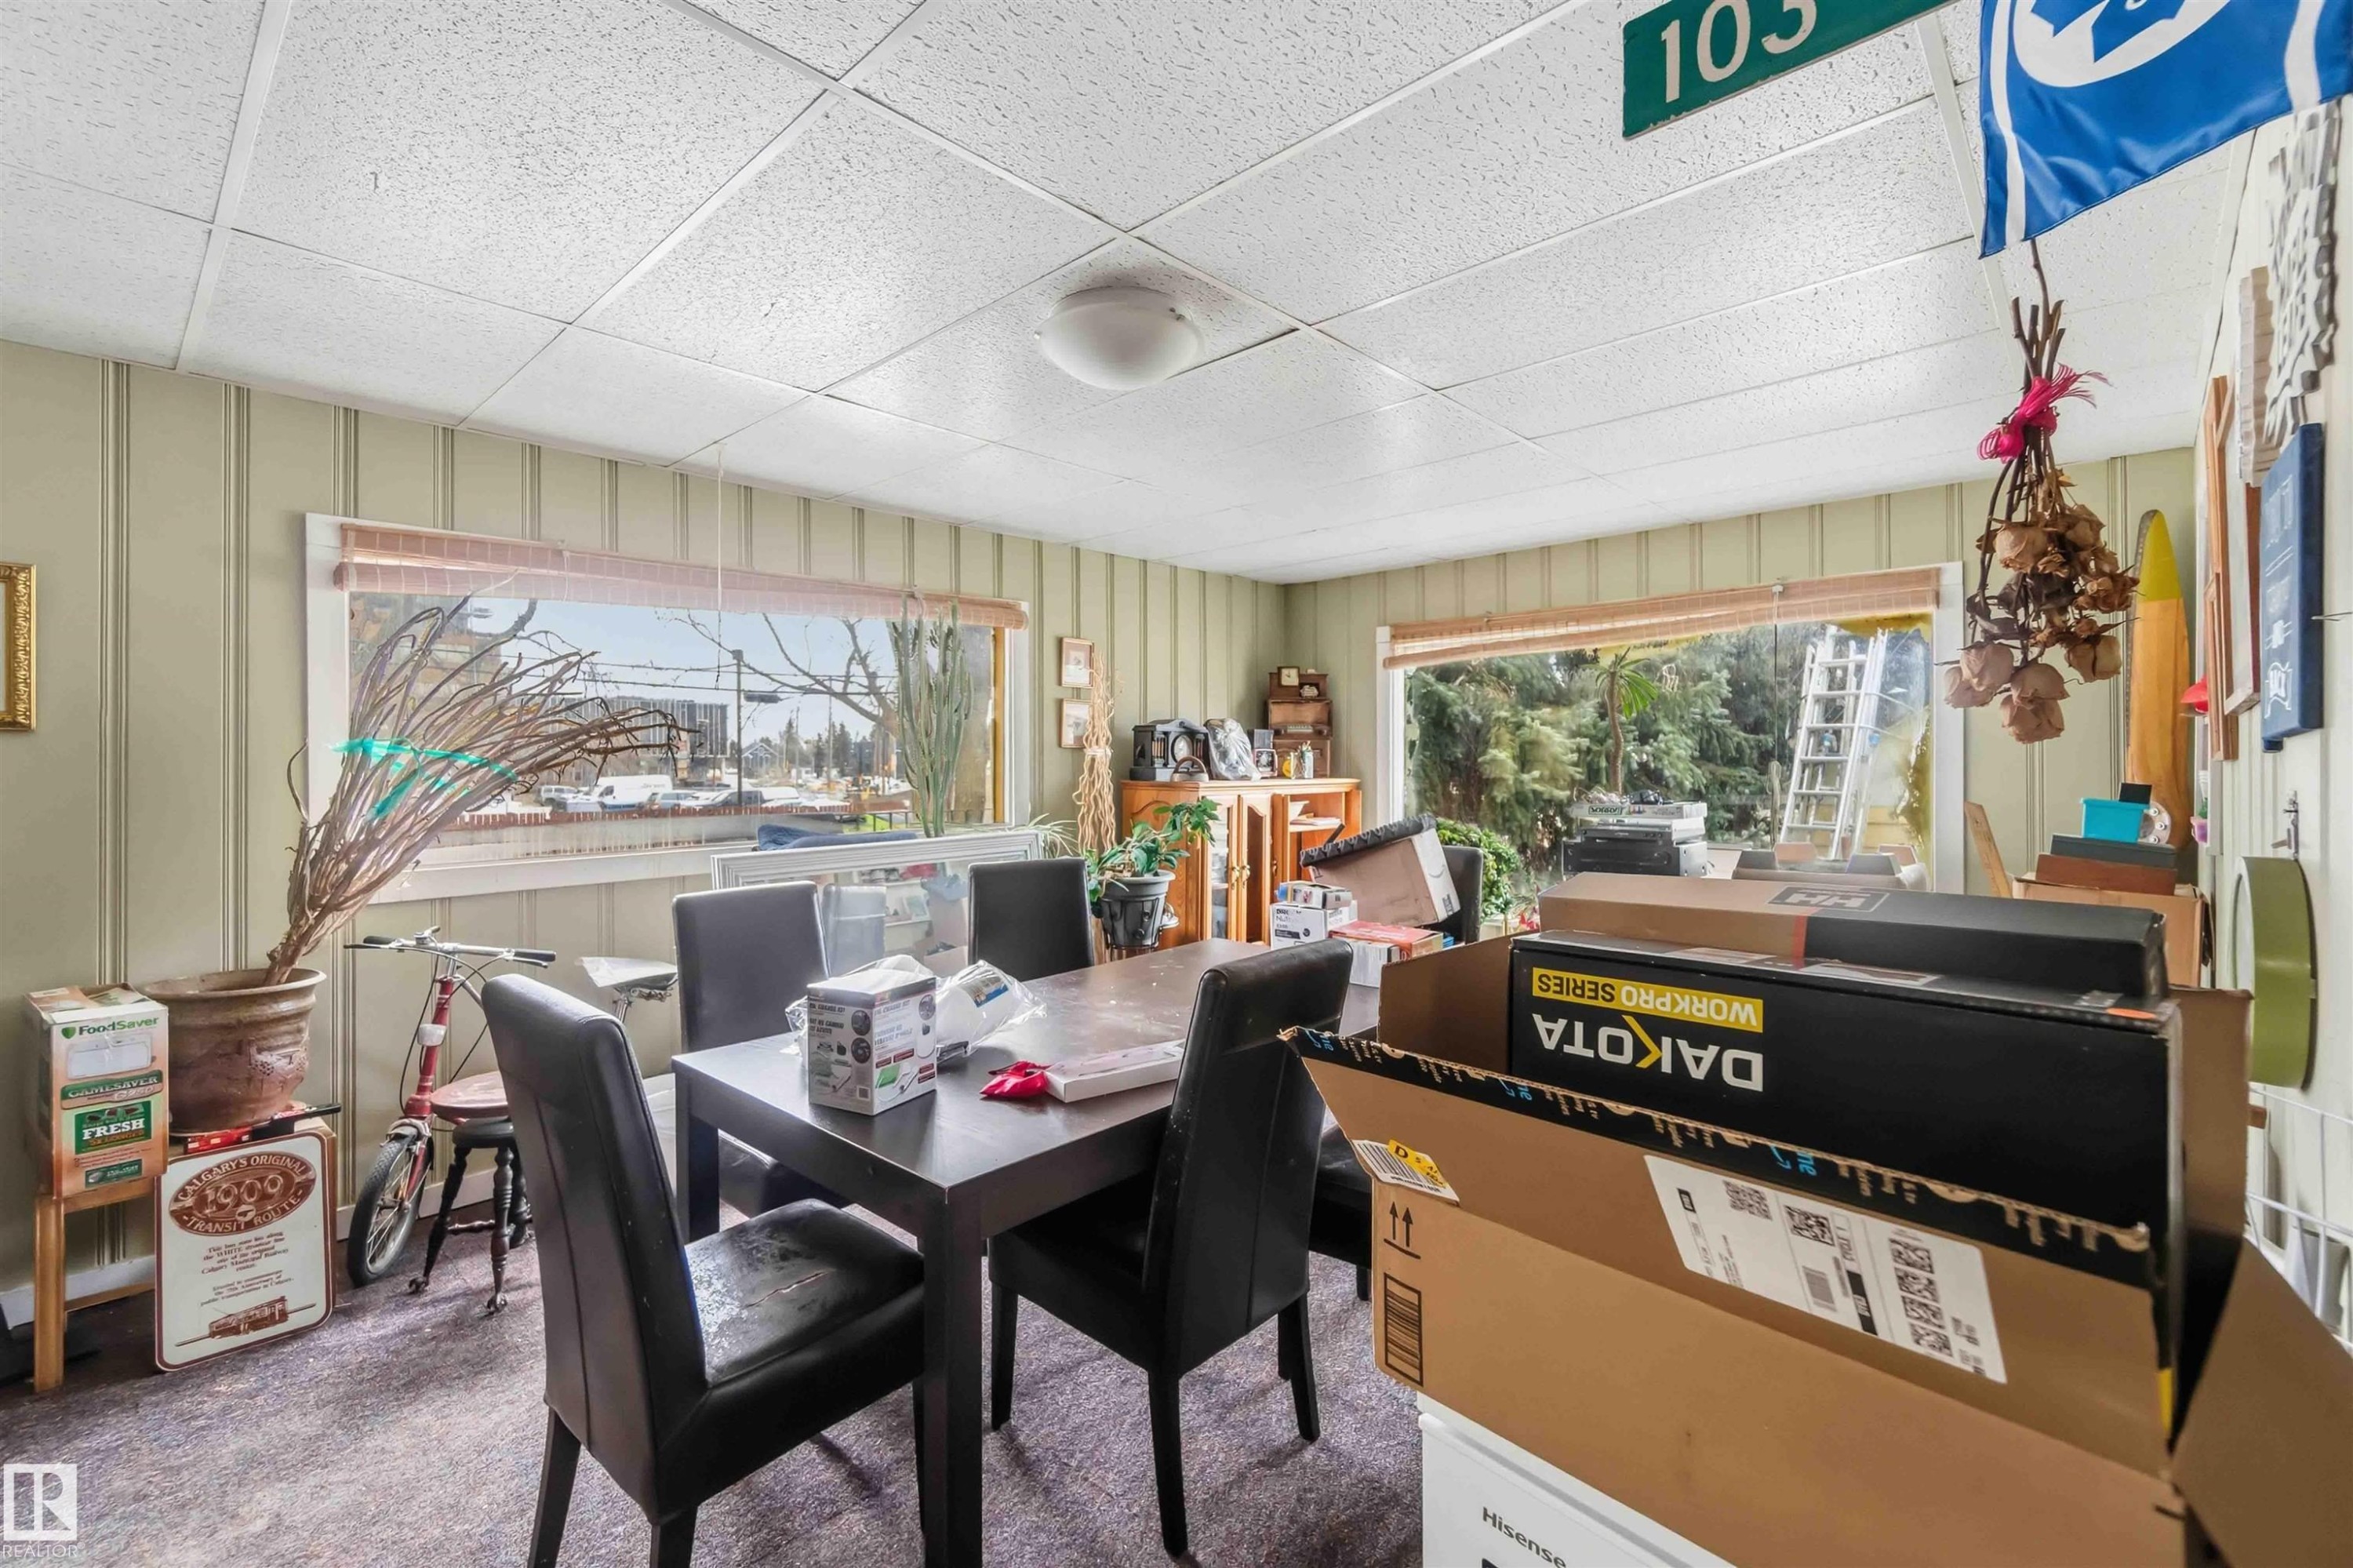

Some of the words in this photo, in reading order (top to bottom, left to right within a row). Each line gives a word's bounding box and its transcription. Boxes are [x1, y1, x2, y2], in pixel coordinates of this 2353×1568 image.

[1537, 973, 1616, 1002] SERIES
[1620, 985, 1758, 1026] WORKPRO
[78, 1017, 159, 1035] FoodSaver
[1532, 1013, 1763, 1092] DAKOTA
[82, 1118, 145, 1140] FRESH
[177, 1157, 248, 1201] CALGARY'S
[250, 1155, 306, 1176] ORIGINAL
[1482, 1506, 1566, 1568] Hisense
